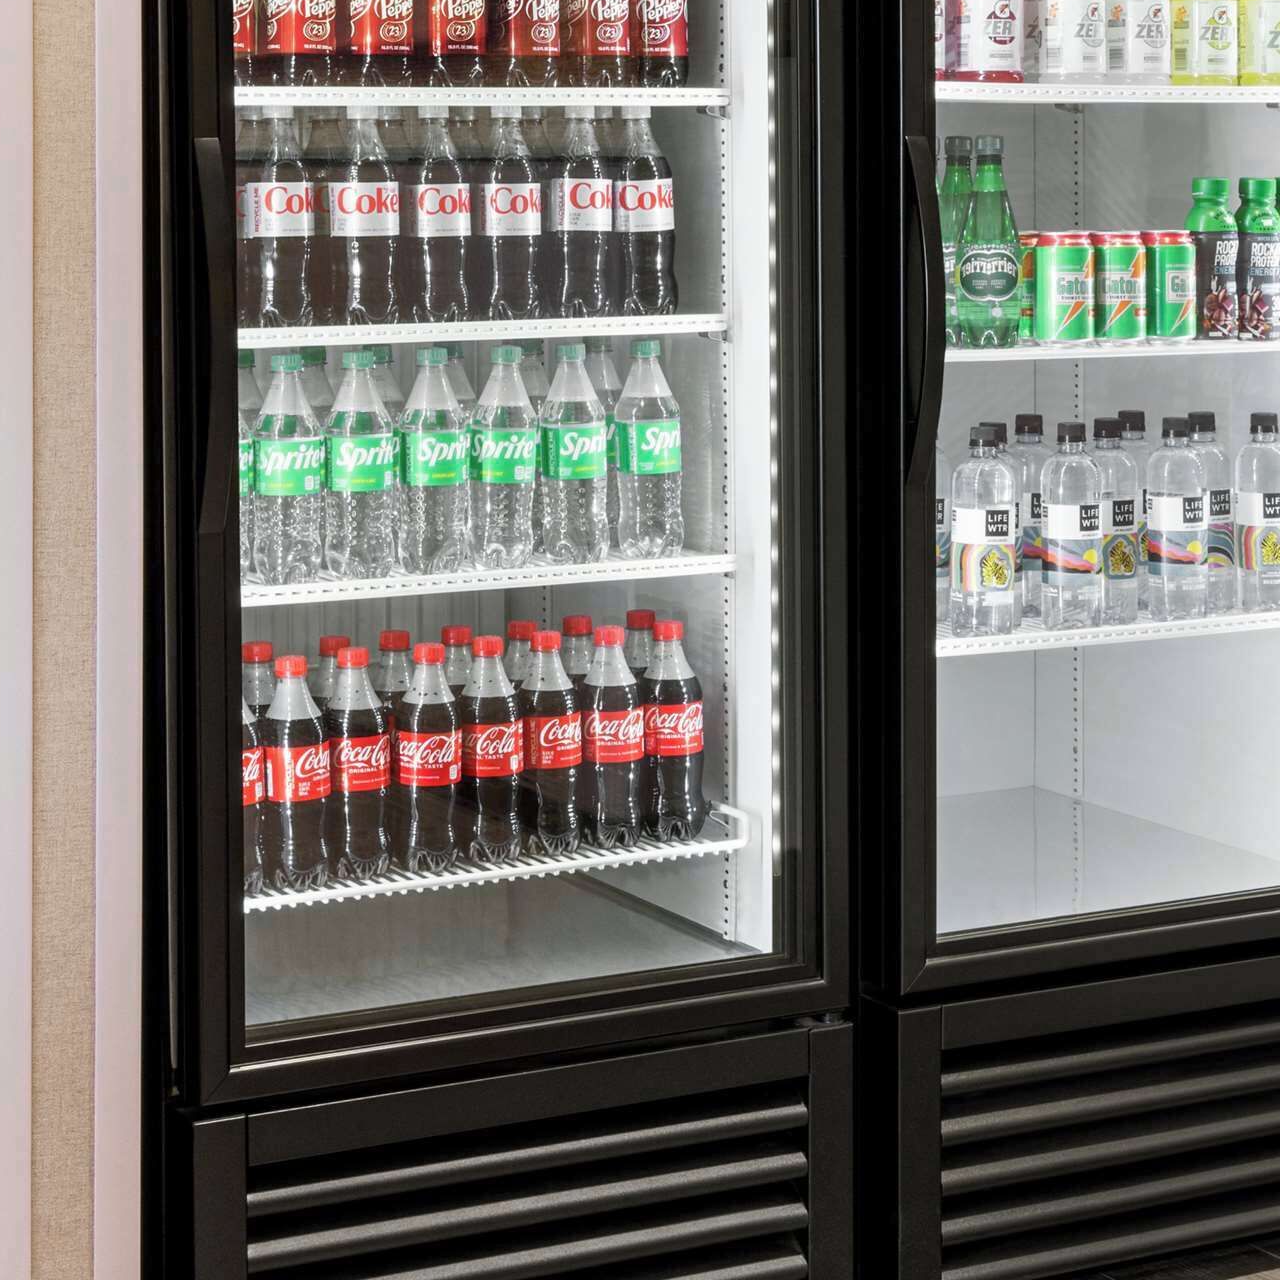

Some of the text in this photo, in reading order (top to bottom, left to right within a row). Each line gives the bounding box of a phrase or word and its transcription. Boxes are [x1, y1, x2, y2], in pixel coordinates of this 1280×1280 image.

[312, 24, 322, 34] 23
[390, 26, 400, 36] 23
[456, 26, 466, 36] 23
[650, 28, 660, 38] 23
[1135, 24, 1166, 39] ZER
[265, 186, 313, 214] Cok
[337, 186, 399, 214] Coke
[418, 187, 471, 215] Cok
[494, 187, 542, 214] Cok
[570, 183, 612, 209] Cok
[471, 433, 536, 463] Sprite
[1212, 493, 1230, 503] LIFE
[988, 514, 1009, 523] LIFE
[987, 523, 1008, 532] WTR
